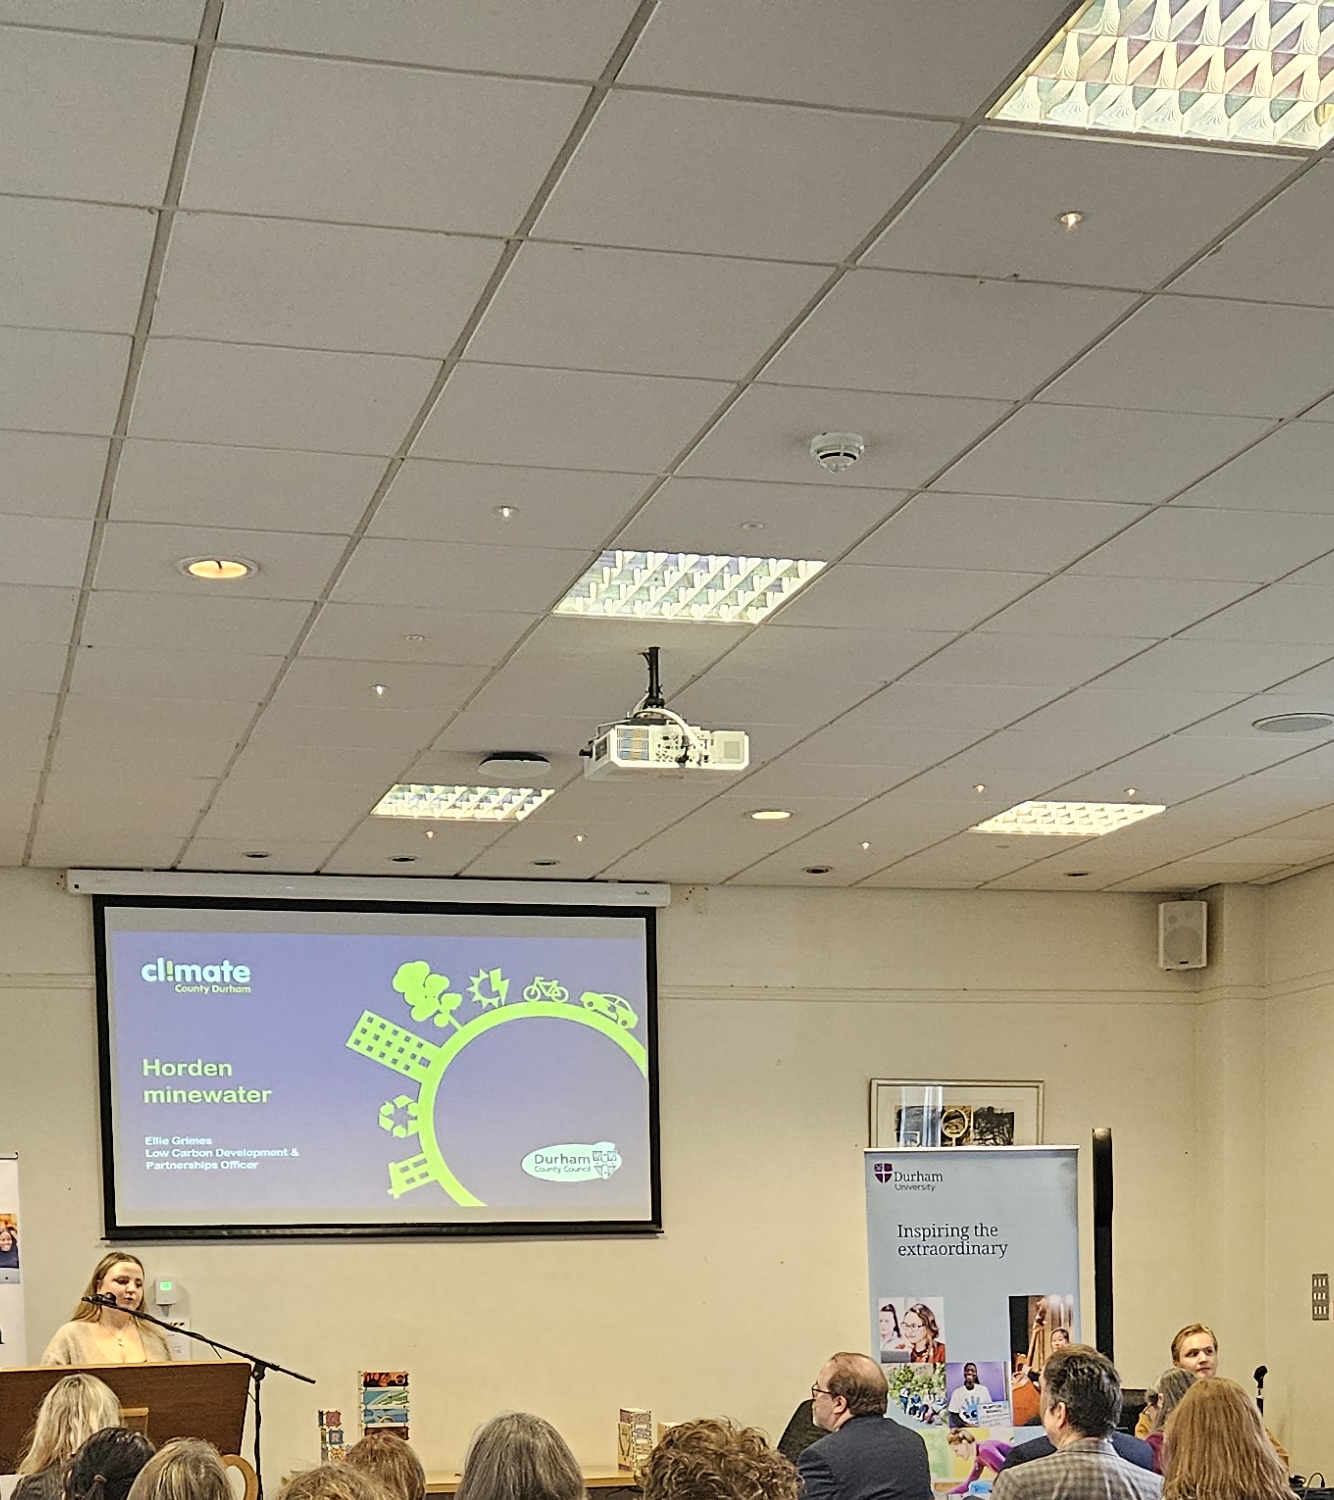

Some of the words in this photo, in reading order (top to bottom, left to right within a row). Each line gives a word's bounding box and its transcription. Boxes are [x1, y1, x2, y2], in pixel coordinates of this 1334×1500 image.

[175, 984, 210, 994] County
[211, 984, 252, 993] Durham
[142, 1059, 233, 1077] Horden
[143, 1085, 273, 1103] minewater
[144, 1136, 170, 1146] Ellie
[171, 1136, 212, 1146] Grimes
[145, 1149, 170, 1158] Low
[171, 1149, 213, 1158] Carbon
[216, 1148, 289, 1159] Development
[290, 1148, 300, 1157] &
[534, 1153, 591, 1165] Durham
[146, 1161, 219, 1171] Partnerships
[220, 1161, 259, 1170] Officer
[534, 1165, 561, 1174] County
[563, 1165, 592, 1173] Council
[894, 1171, 944, 1182] Durham
[895, 1183, 936, 1192] University
[897, 1223, 970, 1241] Inspiring
[974, 1223, 998, 1238] the
[898, 1241, 1008, 1259] extraordinary
